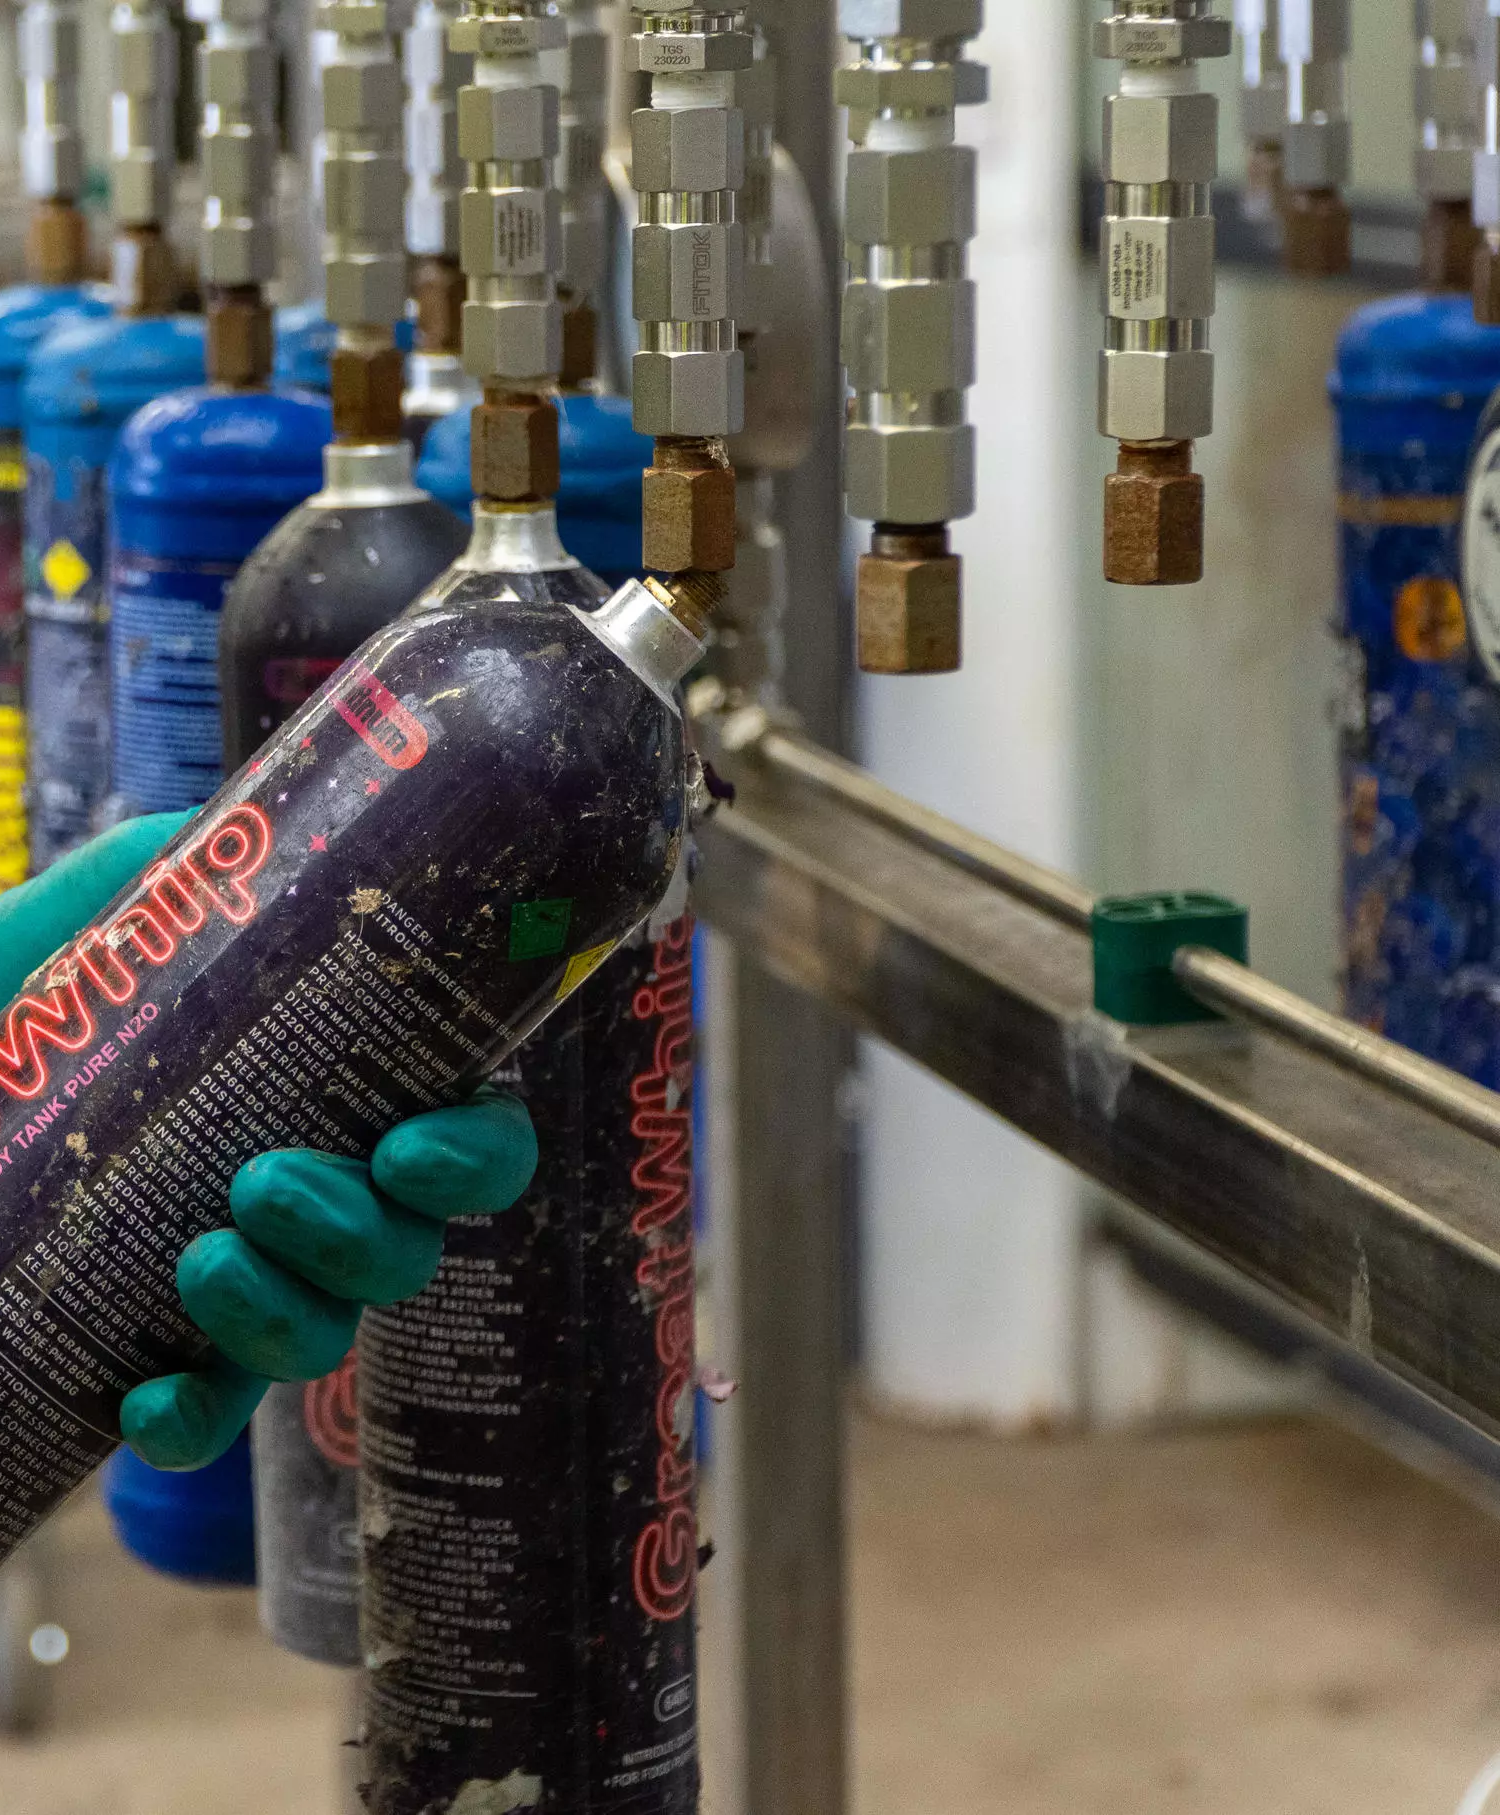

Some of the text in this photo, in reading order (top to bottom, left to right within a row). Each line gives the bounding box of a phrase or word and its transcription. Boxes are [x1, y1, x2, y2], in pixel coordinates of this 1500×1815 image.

[654, 55, 691, 65] 230220
[661, 45, 684, 55] TGS
[693, 231, 711, 315] FITOK
[343, 683, 410, 757] tinum
[366, 906, 422, 959] ITROUS
[380, 893, 434, 946] DANGER!
[284, 989, 350, 1055] DIZZINESS.
[402, 985, 441, 1023] CAUSE
[438, 1019, 456, 1036] OR
[13, 1096, 67, 1150] TANK
[63, 1041, 121, 1098] PURE
[115, 1000, 160, 1044] N2O
[258, 1013, 288, 1043] AND
[286, 1039, 328, 1080] OTHER
[271, 1001, 394, 1117] P220:KEEP AWAY FROM
[354, 1034, 394, 1072] CAUSE
[391, 1045, 436, 1084] EXPLODE
[175, 1097, 238, 1158] FIRE:STOP
[188, 1085, 224, 1122] PRAY.
[222, 1118, 262, 1157] P370+
[199, 1073, 283, 1154] DUST/FUMES/
[211, 1062, 291, 1137] P260:DO NOT
[223, 1050, 257, 1083] FREE
[255, 1079, 291, 1114] FROM
[289, 1110, 312, 1133] OIL
[309, 1128, 334, 1153] AND
[235, 1038, 300, 1101] P244:KEEP
[298, 1097, 341, 1136] VALVES
[338, 1131, 361, 1153] AND
[128, 1146, 188, 1202] POSITION
[139, 1134, 222, 1210] AIR AND KEEP
[164, 1109, 237, 1181] P304+P340
[92, 1181, 166, 1251] P403:STORE
[104, 1169, 159, 1223] MEDICAL
[157, 1219, 190, 1251] ADVI
[22, 1253, 55, 1287] KEE
[53, 1283, 87, 1316] AWAY
[85, 1312, 119, 1343] FROM
[117, 1338, 160, 1373] CHILDRE
[45, 1229, 89, 1272] LIQUID
[88, 1269, 114, 1295] MAY
[112, 1291, 151, 1327] CAUSE
[147, 1321, 176, 1346] COLD
[0, 1325, 80, 1397] WEIGHT:640G
[31, 1308, 58, 1334] 678
[55, 1330, 98, 1369] GRAMS
[95, 1364, 133, 1396] VOLUM
[6, 1397, 63, 1445] PRESSURE
[36, 1401, 61, 1423] FOR
[3, 1498, 31, 1518] WHEN
[11, 1485, 32, 1502] THE
